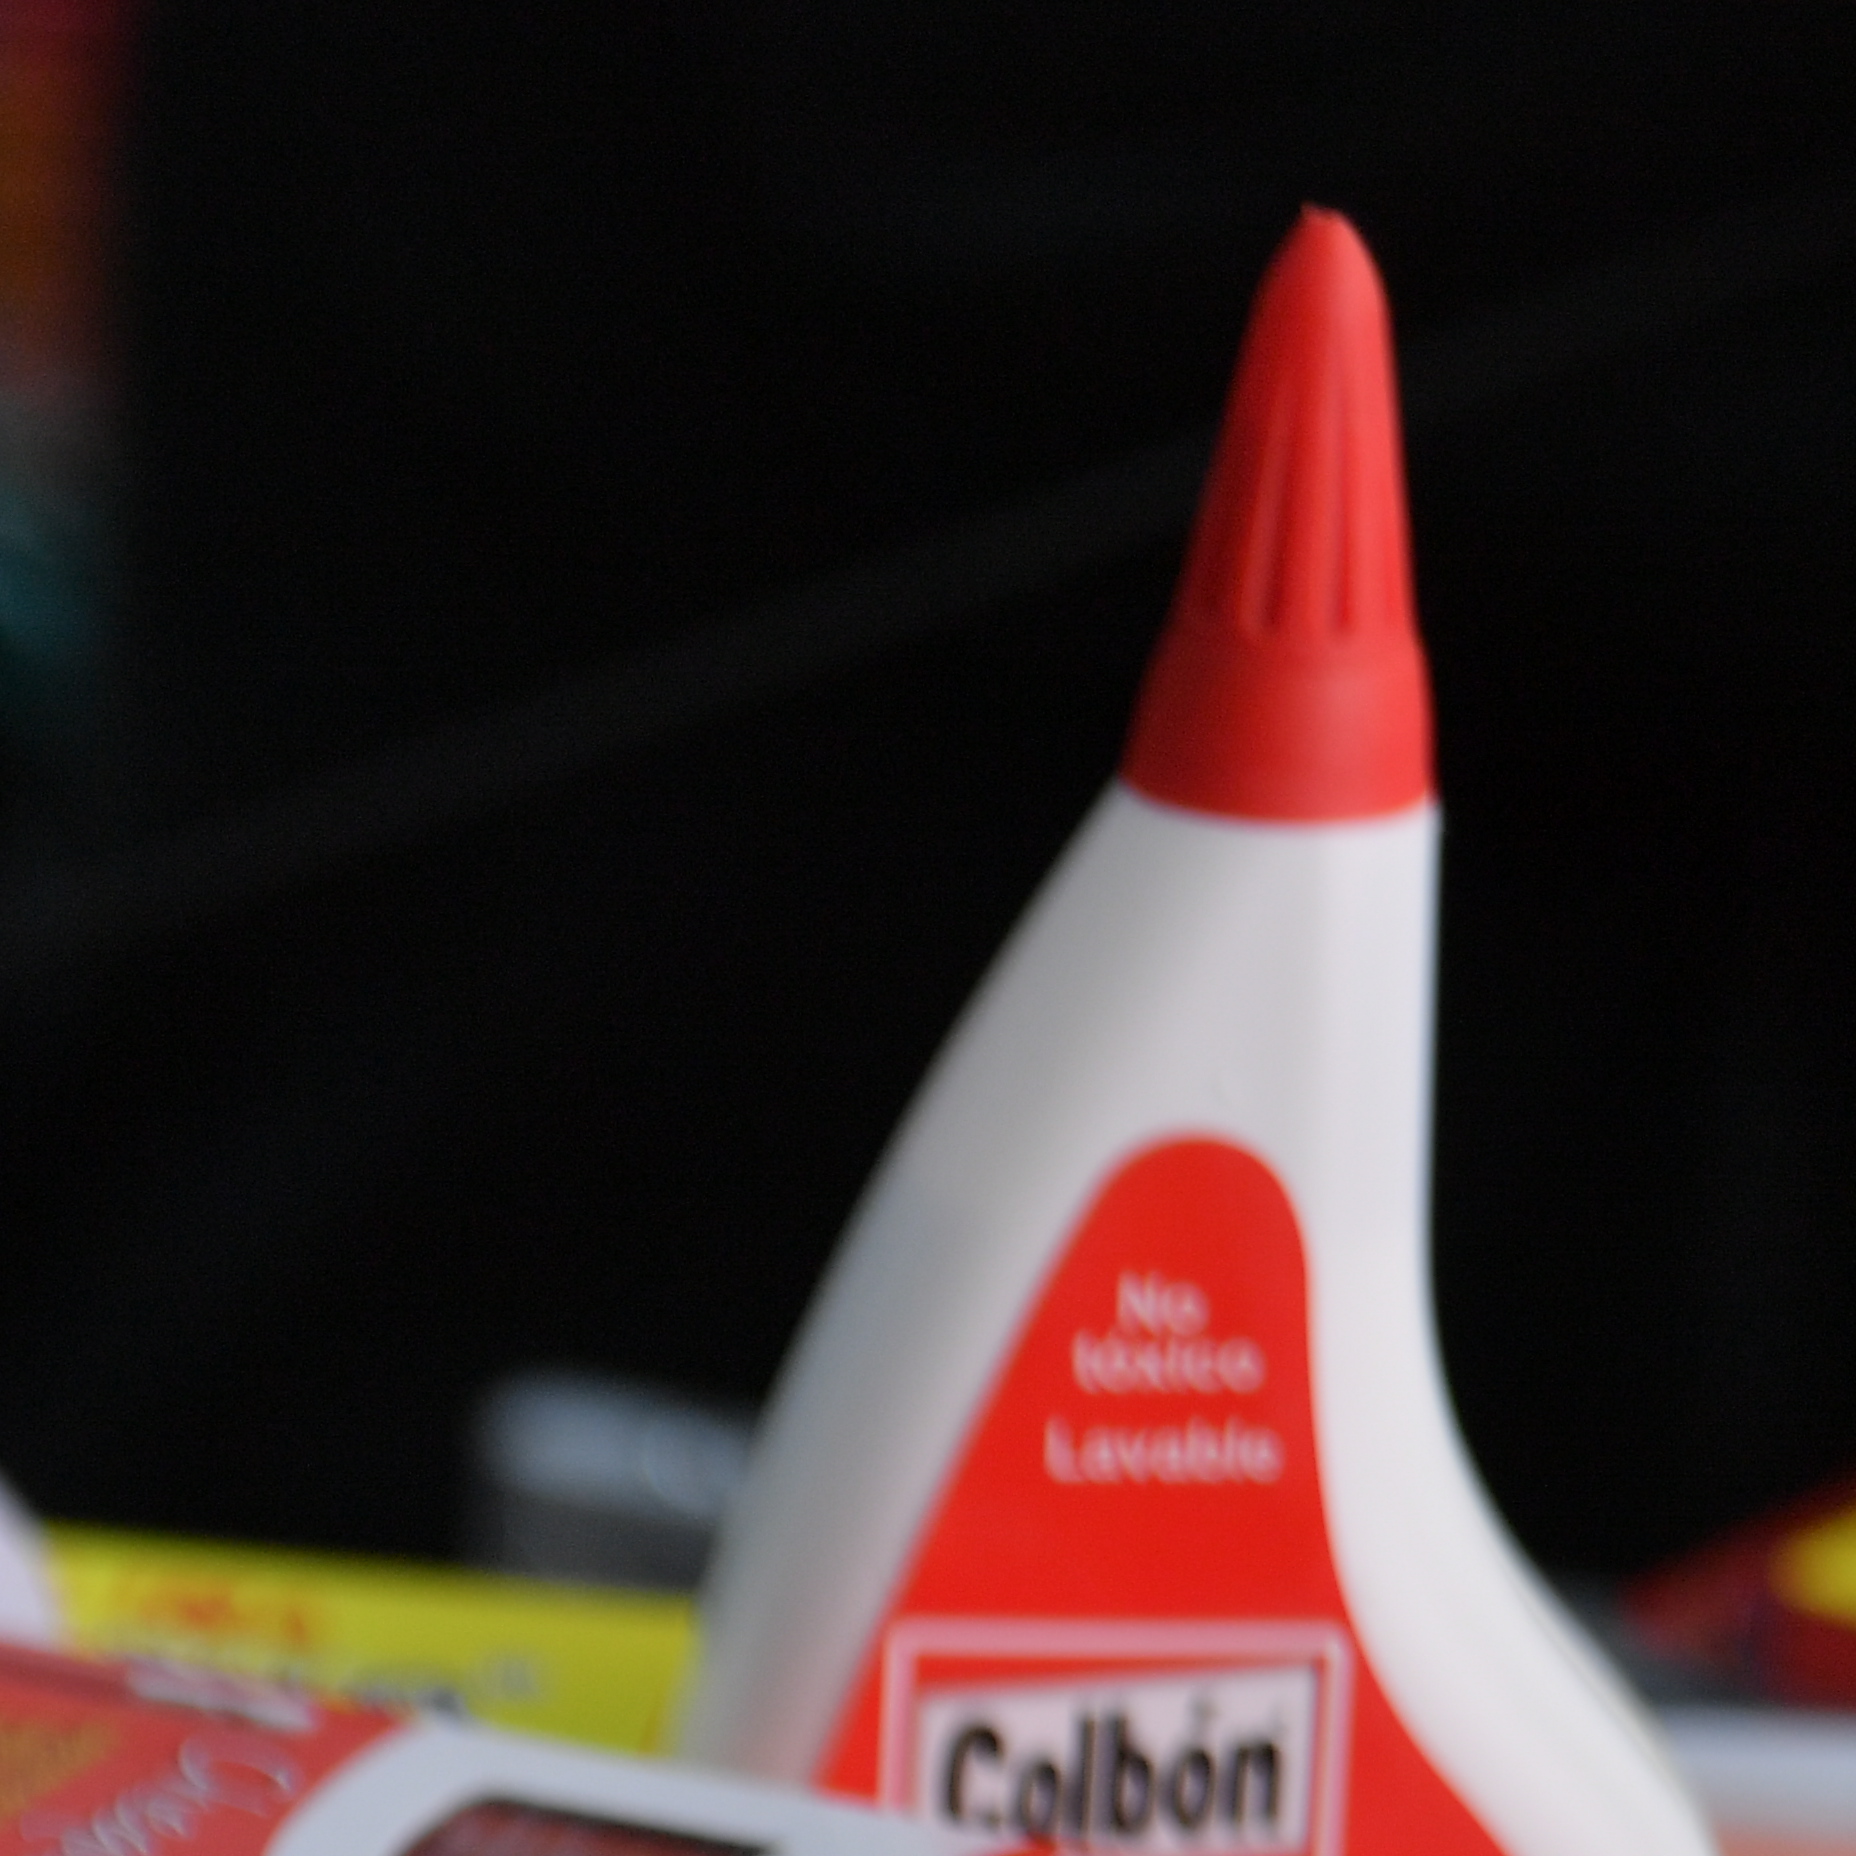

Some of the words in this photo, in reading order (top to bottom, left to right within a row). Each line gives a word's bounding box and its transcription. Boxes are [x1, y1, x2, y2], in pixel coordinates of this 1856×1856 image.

[1117, 1271, 1208, 1338] No
[1043, 1414, 1285, 1484] Lavable
[943, 1690, 1281, 1838] Colbón
